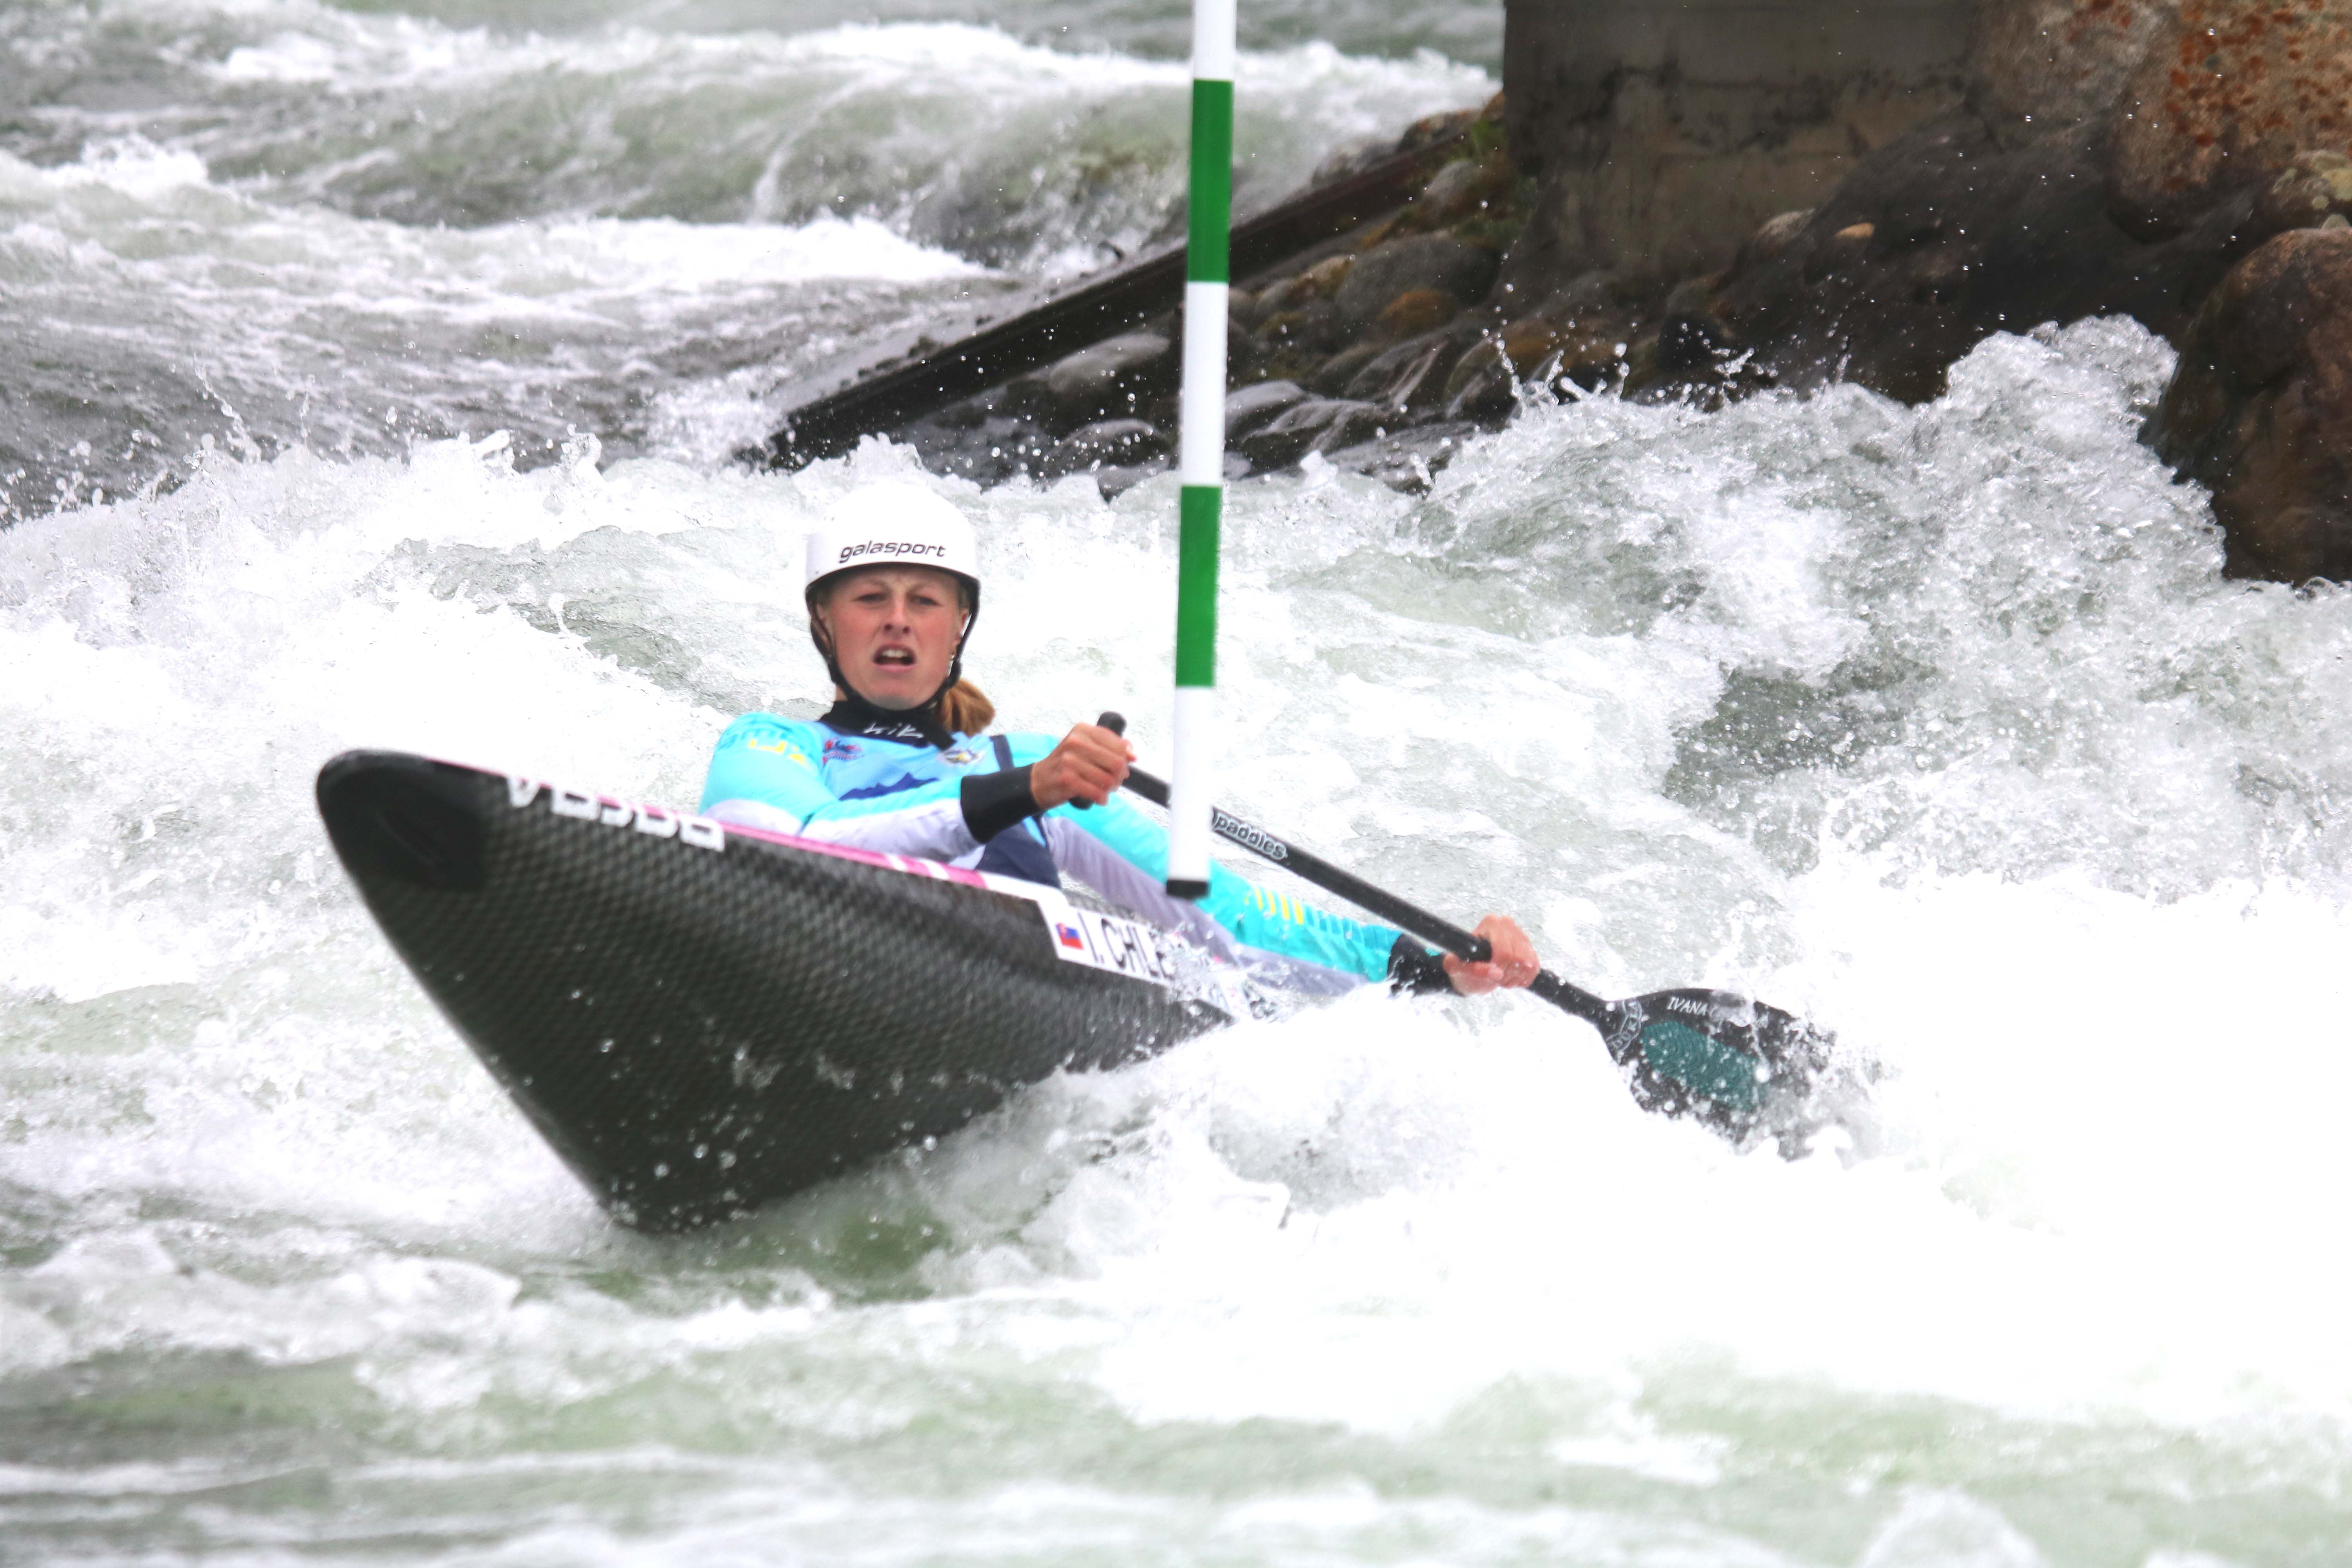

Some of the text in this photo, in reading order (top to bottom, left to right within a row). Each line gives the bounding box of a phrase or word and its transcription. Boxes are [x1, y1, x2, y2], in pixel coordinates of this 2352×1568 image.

[839, 540, 946, 563] galasport
[1214, 813, 1287, 860] paddles
[1667, 997, 1709, 1016] IVANA
